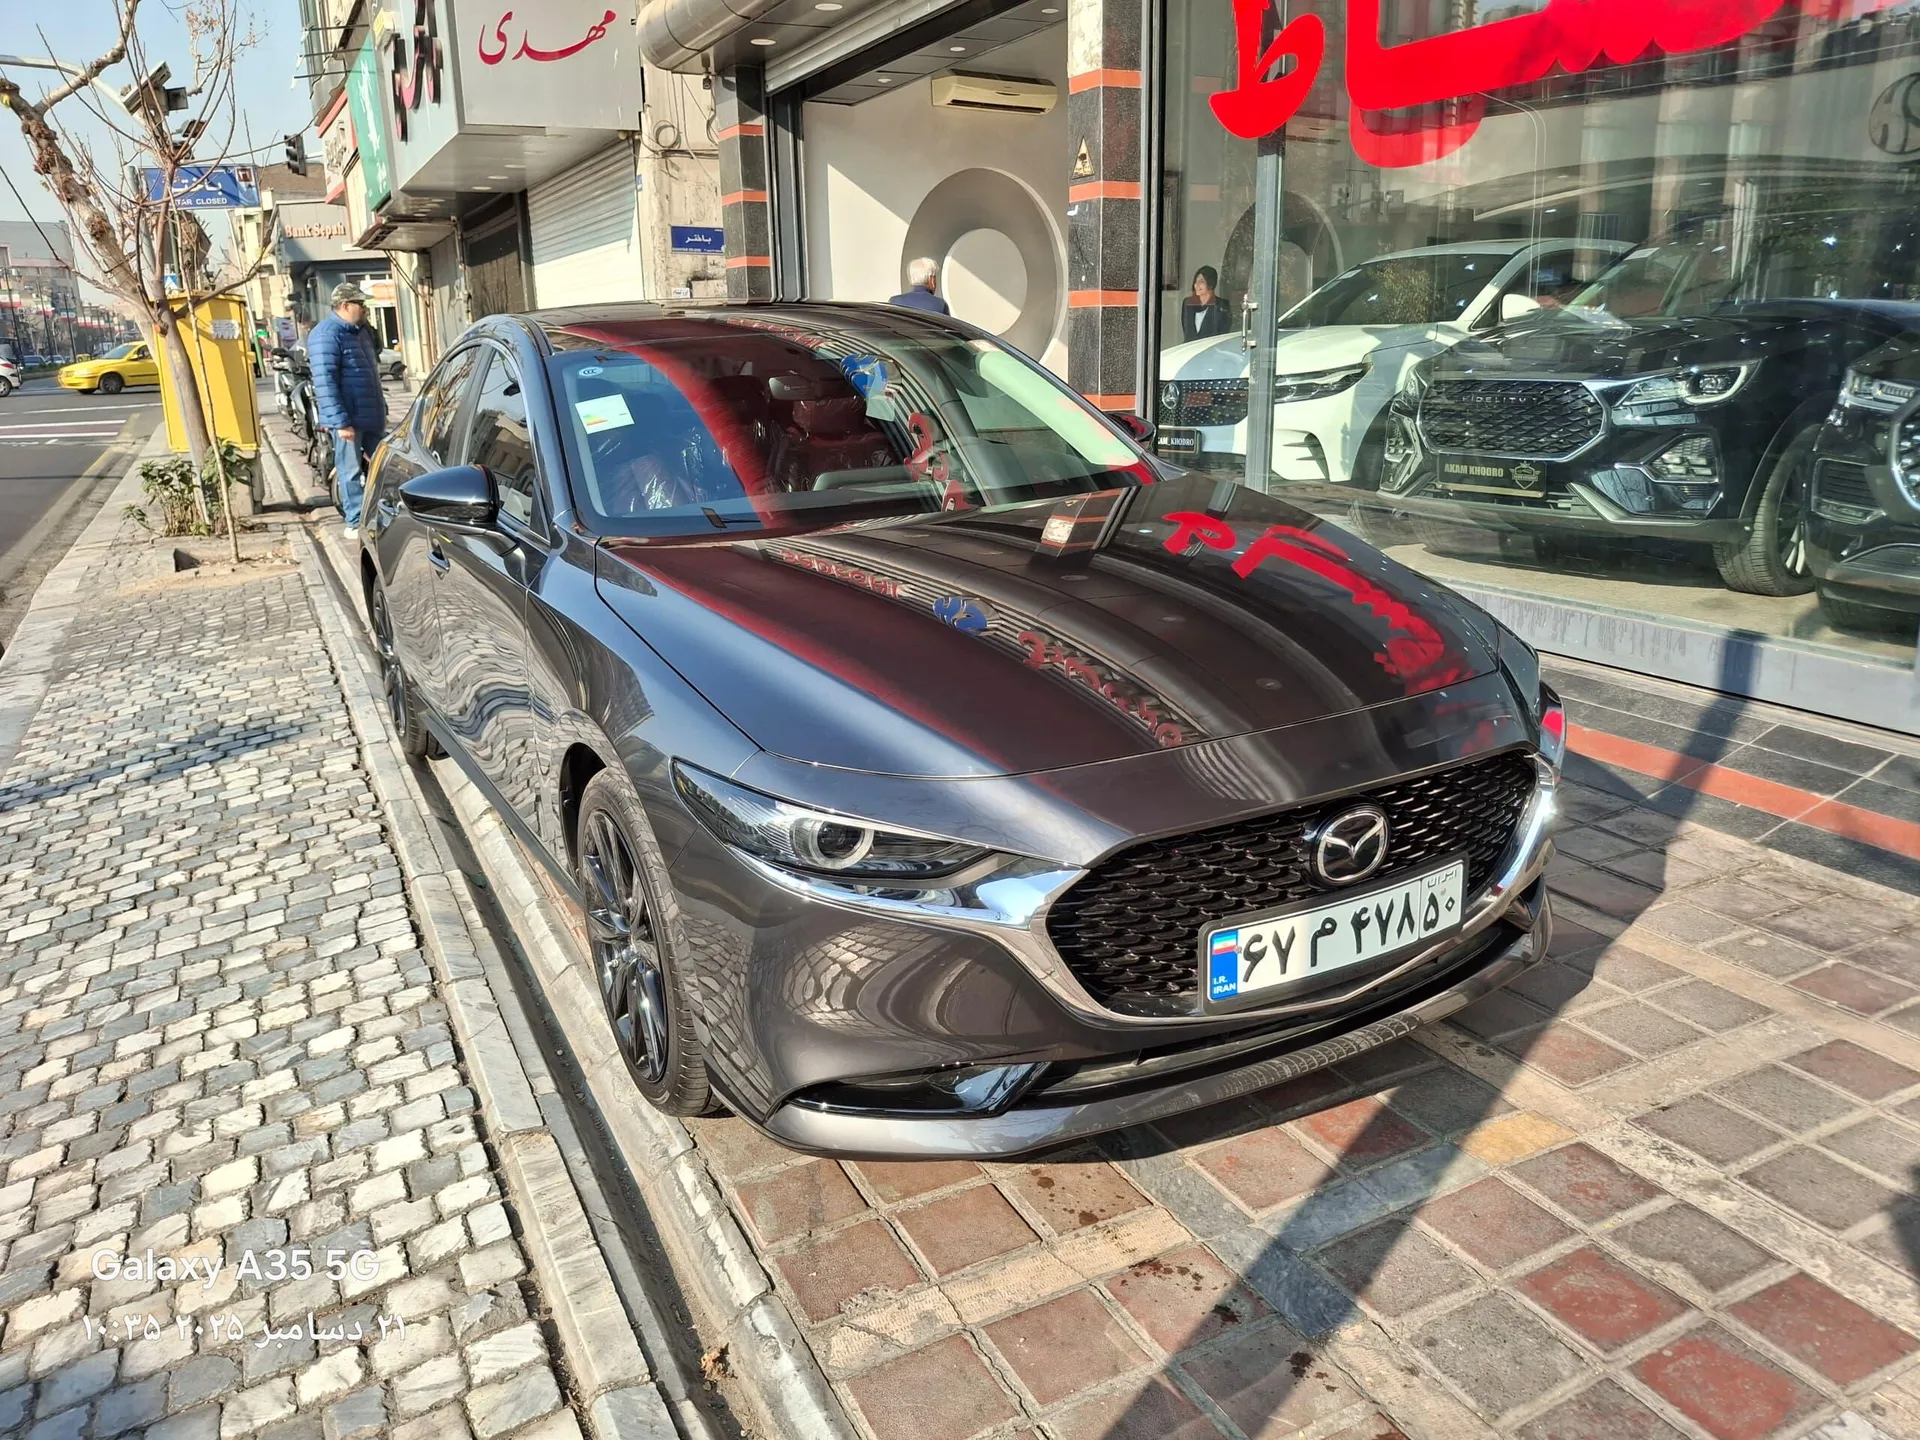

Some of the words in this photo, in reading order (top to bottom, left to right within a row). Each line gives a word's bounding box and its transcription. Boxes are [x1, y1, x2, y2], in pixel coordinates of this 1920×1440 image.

[478, 9, 617, 66] مهدی
[195, 198, 228, 206] CLOSED
[284, 224, 312, 239] Bank
[685, 234, 712, 245] باختر
[1444, 463, 1468, 475] AKAM
[1469, 465, 1504, 478] KHODRO
[1242, 925, 1296, 983] ۶۷
[1349, 892, 1416, 955] ۴۷۸
[1422, 892, 1456, 932] ۵۰
[1213, 976, 1228, 986] I.R.
[1213, 983, 1236, 995] IRAN
